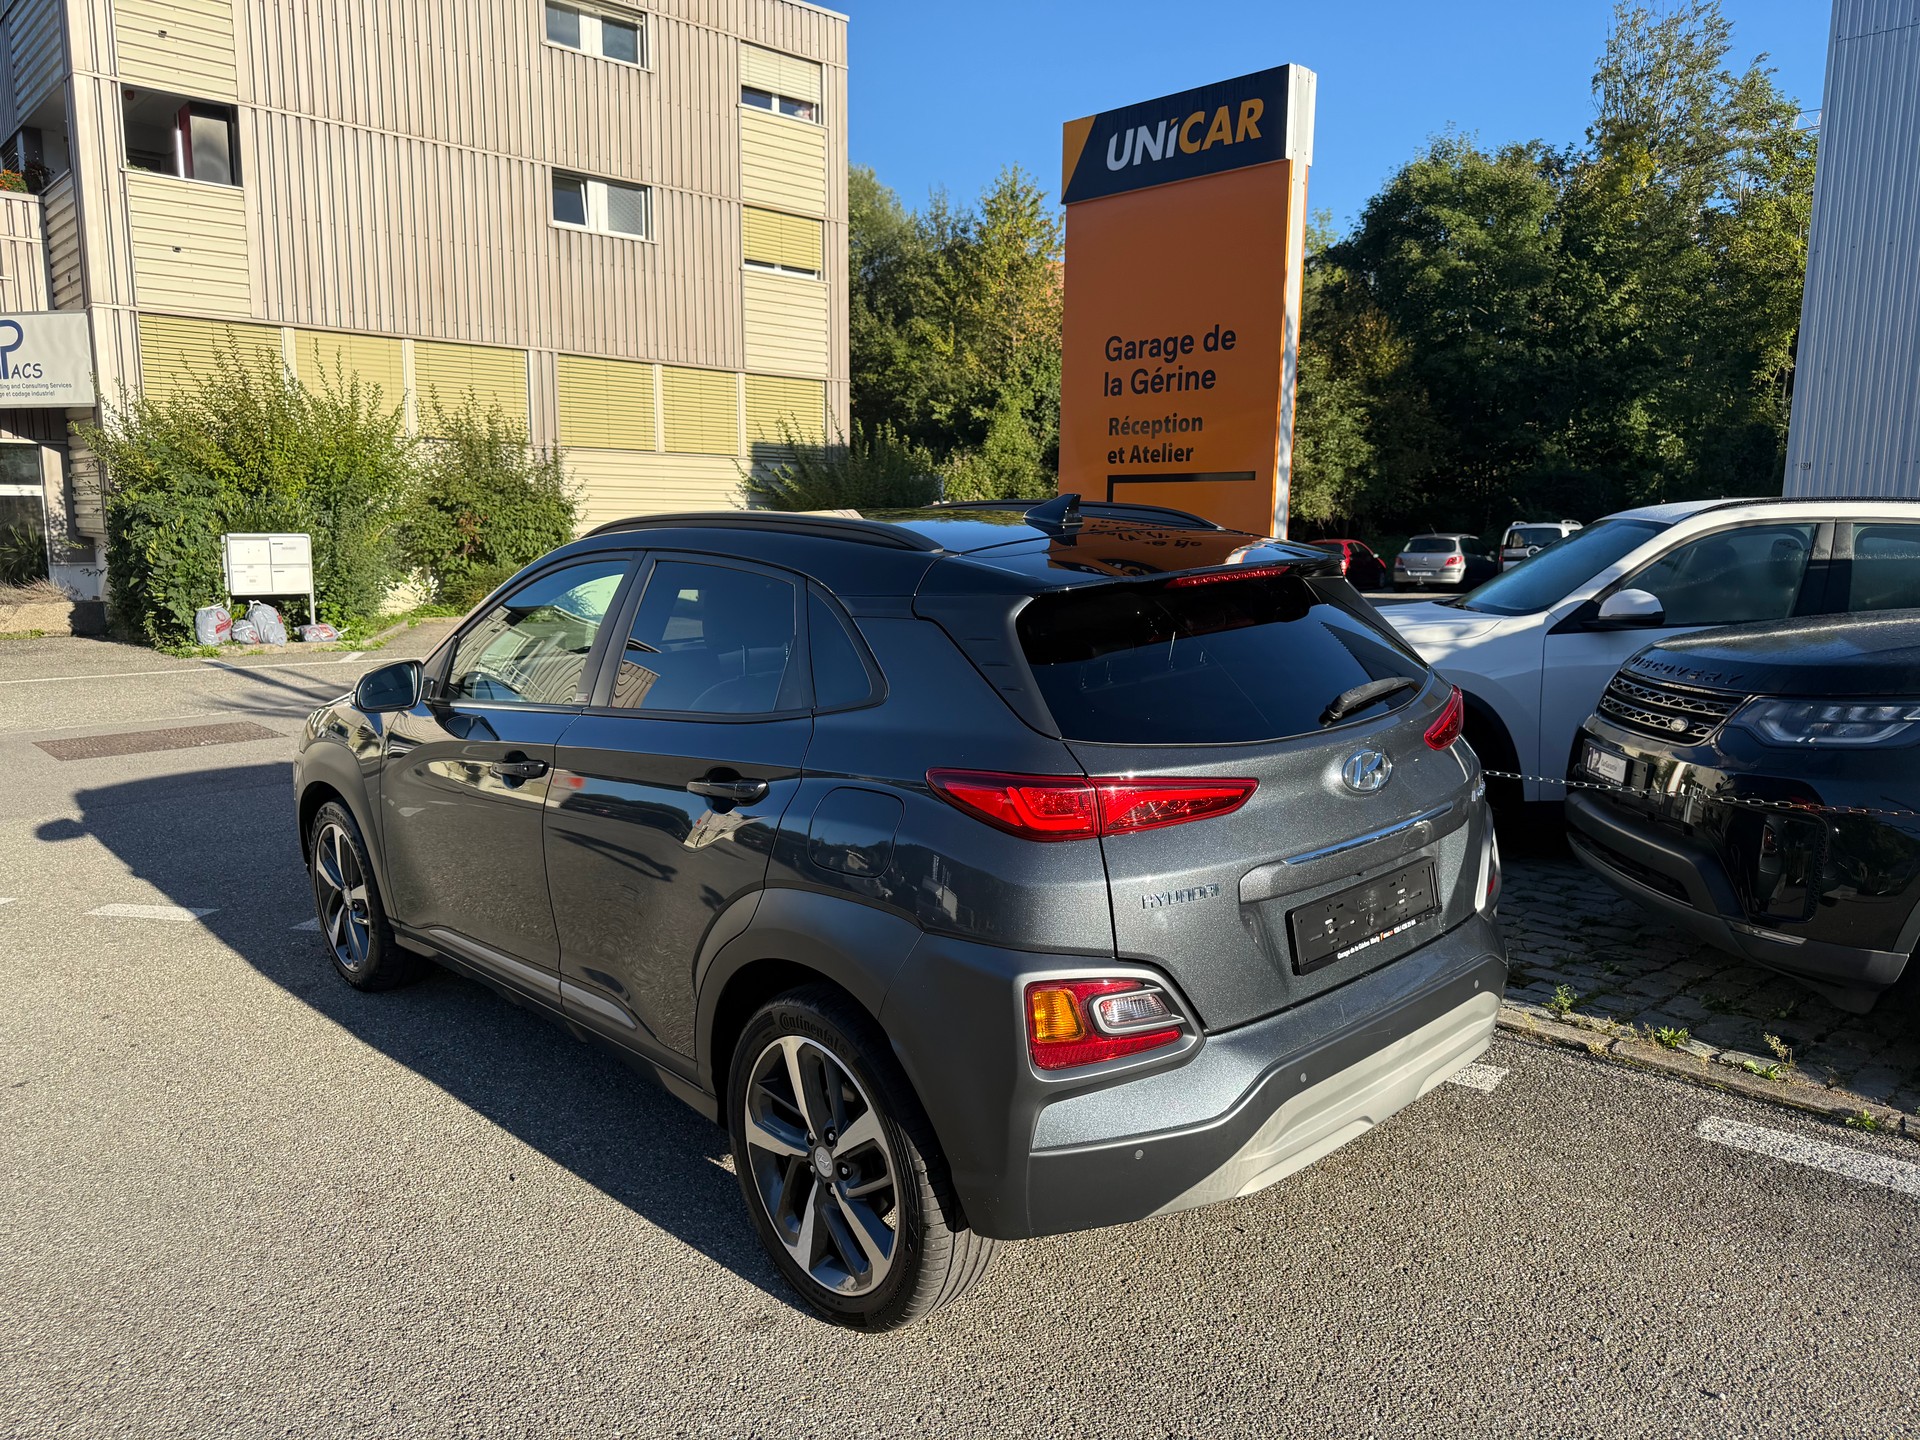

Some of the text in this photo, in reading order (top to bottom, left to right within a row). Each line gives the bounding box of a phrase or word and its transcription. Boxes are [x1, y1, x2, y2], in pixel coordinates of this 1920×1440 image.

[1105, 324, 1236, 363] Garage de
[21, 382, 49, 390] Consulting
[1103, 365, 1216, 397] la Gérine
[1108, 412, 1204, 439] Réception
[1107, 442, 1194, 464] et Atelier
[1632, 656, 1744, 685] DISCOVERY
[1141, 882, 1219, 909] HYUNDAI
[780, 1012, 839, 1051] Continental
